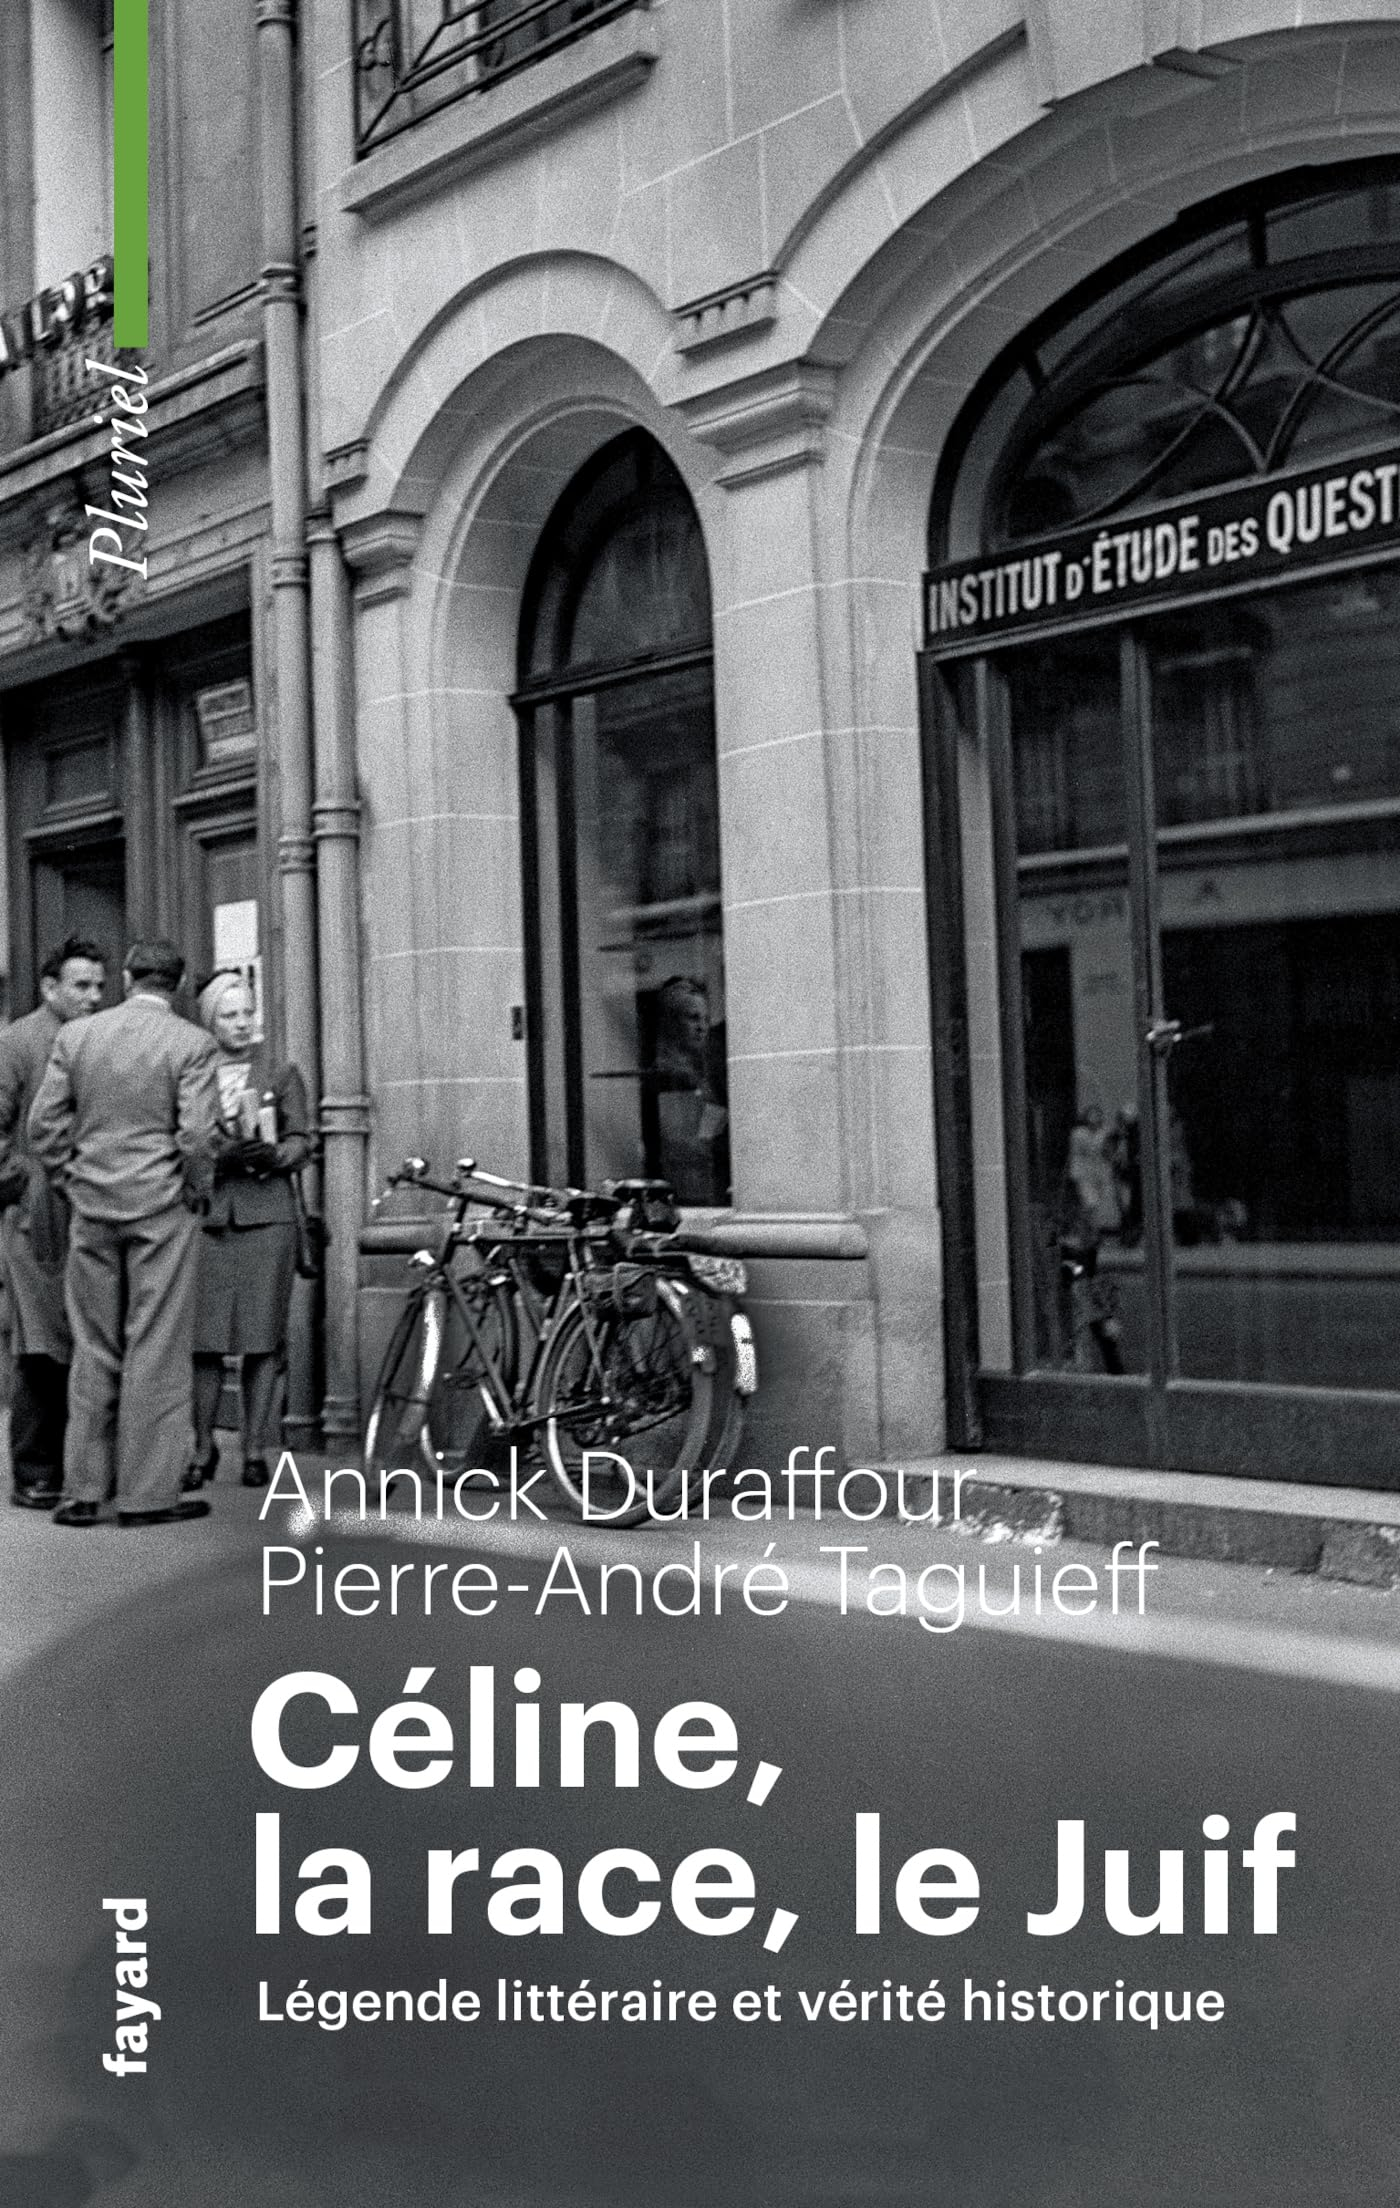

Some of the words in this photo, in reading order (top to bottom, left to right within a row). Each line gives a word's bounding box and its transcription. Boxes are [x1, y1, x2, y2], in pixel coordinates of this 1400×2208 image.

[928, 550, 1063, 633] INSTITUT
[1207, 517, 1260, 567] DES
[1266, 463, 1400, 555] QUEST
